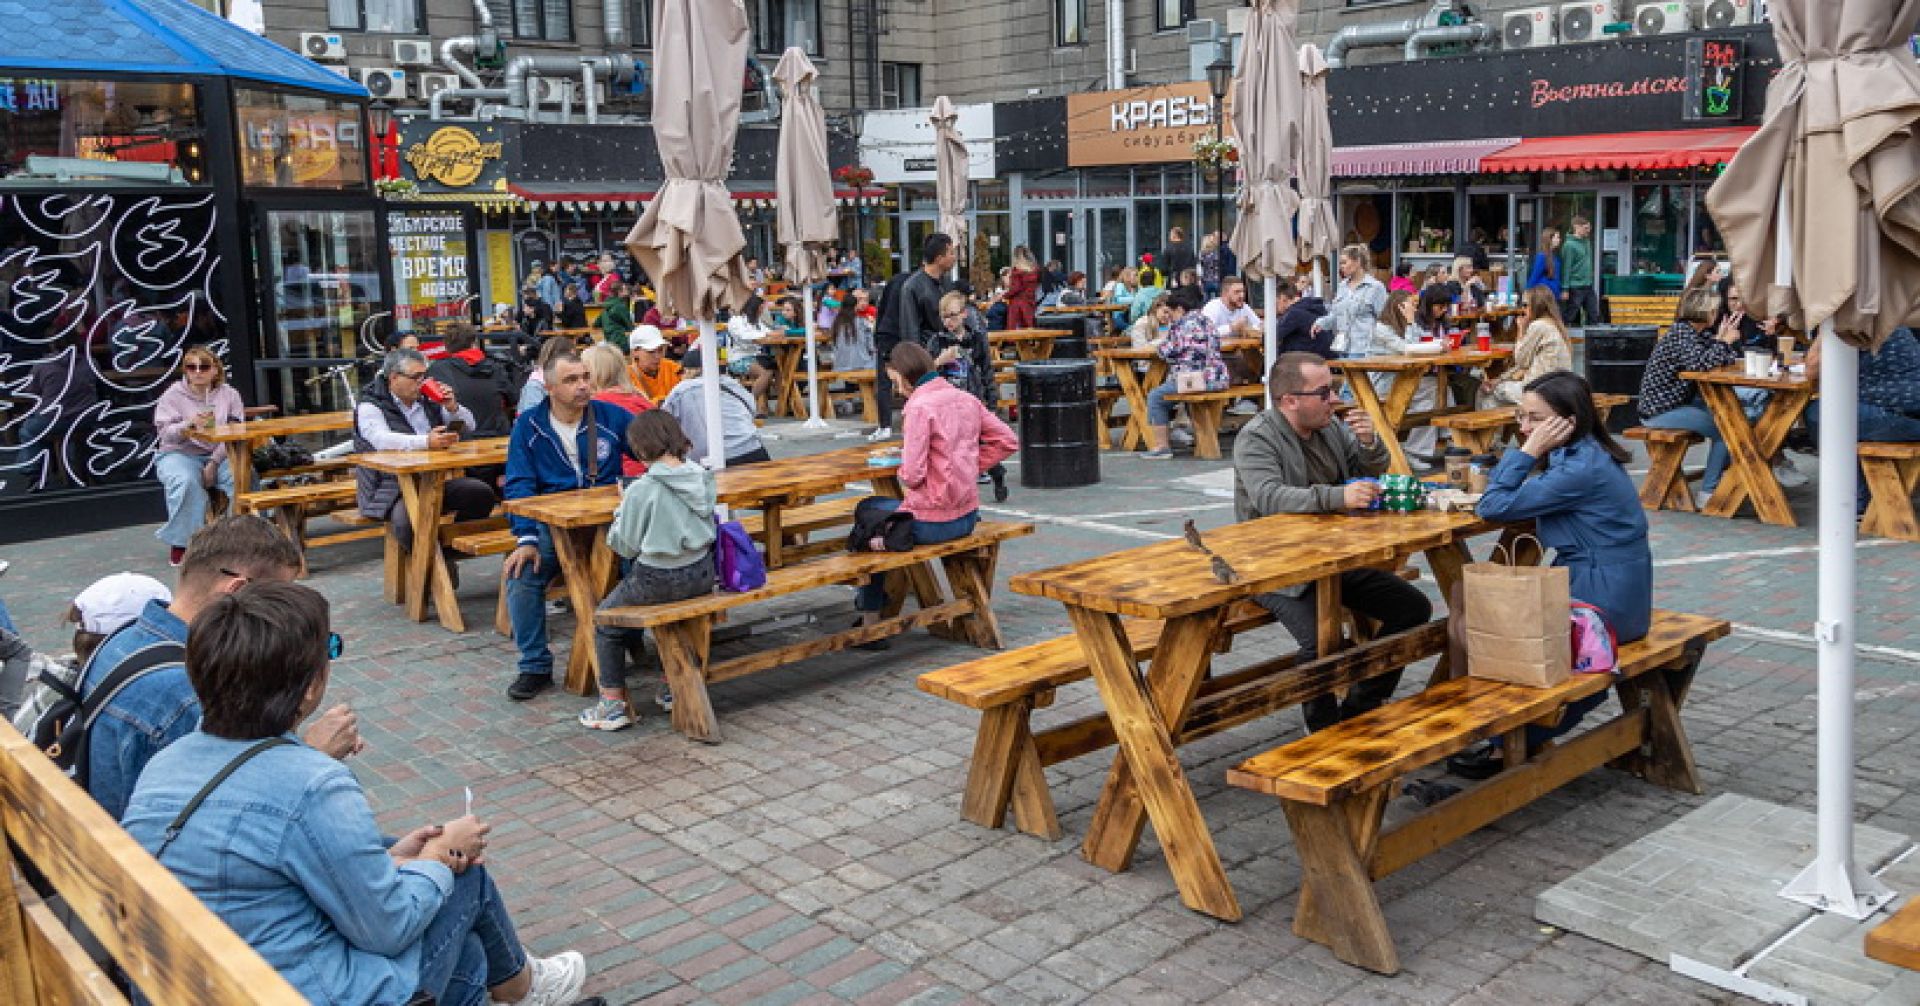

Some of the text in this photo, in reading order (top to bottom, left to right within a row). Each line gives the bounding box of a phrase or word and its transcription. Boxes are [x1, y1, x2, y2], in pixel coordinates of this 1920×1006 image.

[1111, 95, 1214, 132] КРАБЫ
[401, 256, 467, 278] ВРЕМЯ
[420, 279, 467, 297] НОВЫХ
